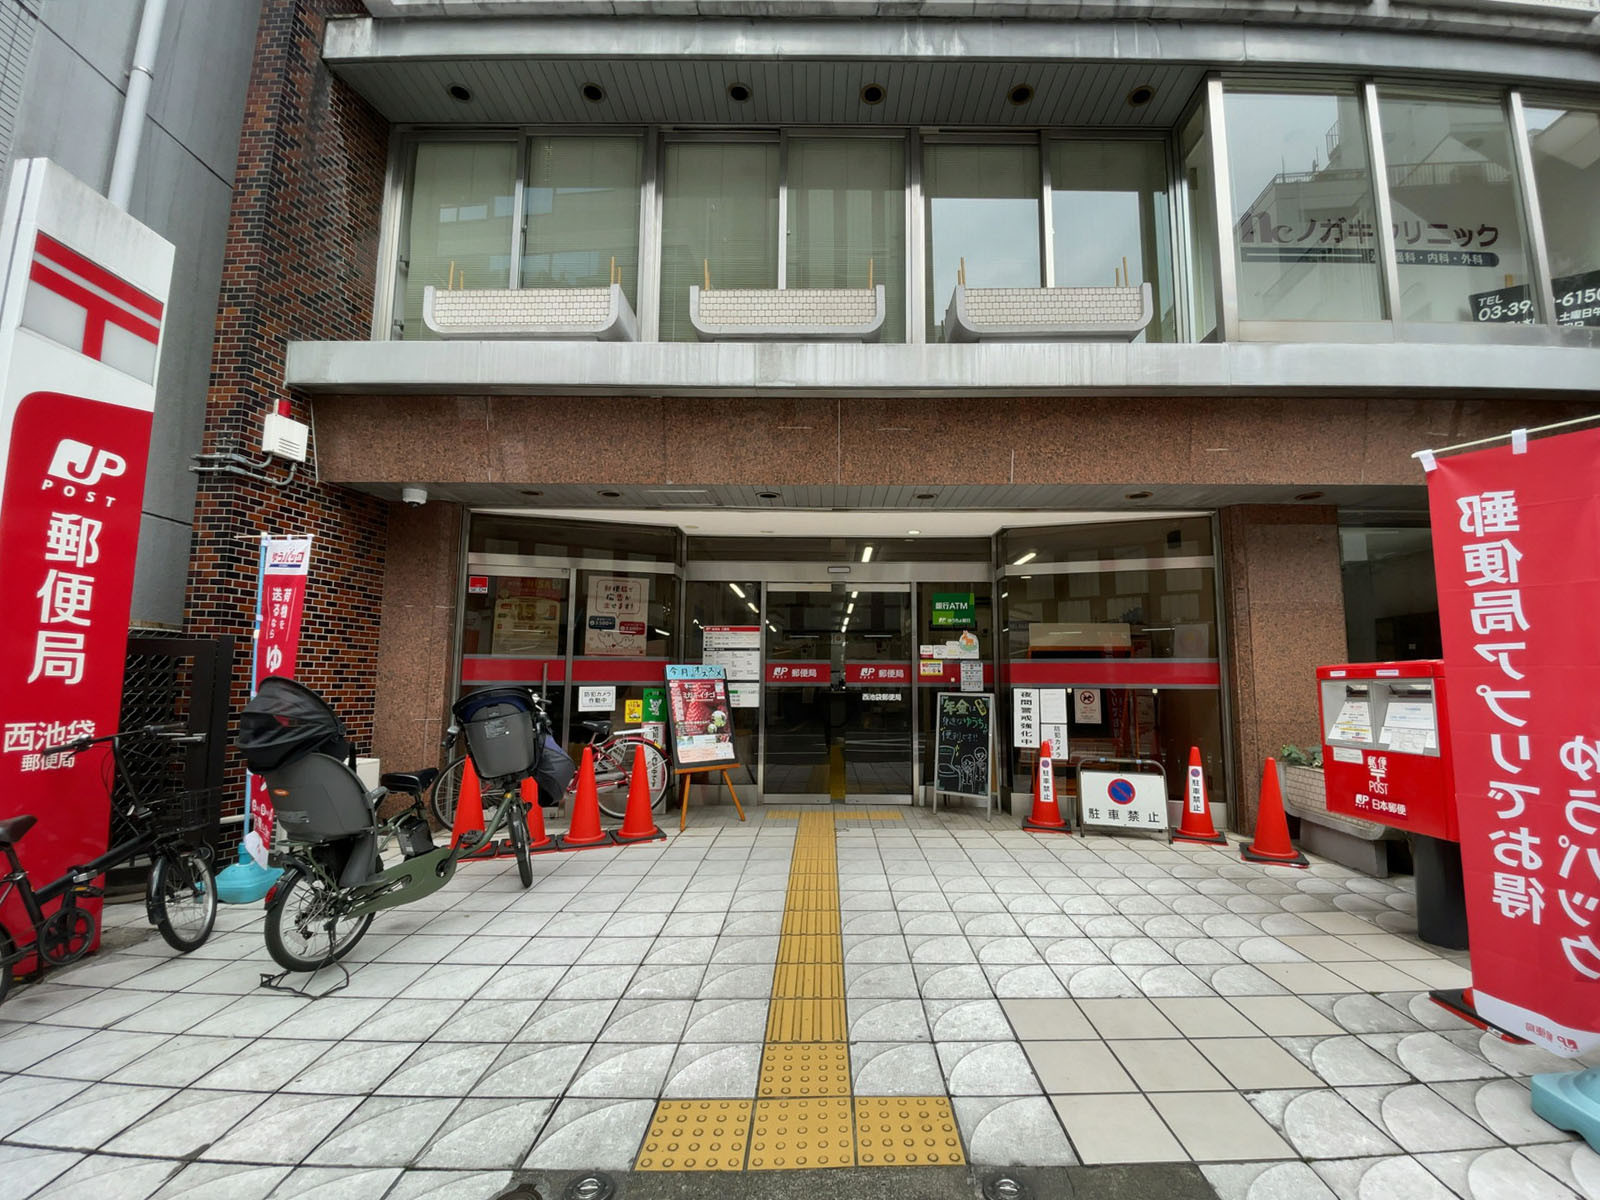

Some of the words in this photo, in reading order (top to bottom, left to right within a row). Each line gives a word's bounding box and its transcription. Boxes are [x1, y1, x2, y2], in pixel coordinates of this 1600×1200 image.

[1478, 295, 1504, 307] TEL
[47, 438, 127, 486] JP
[41, 478, 117, 508] POST
[27, 511, 103, 686] 郵便局
[935, 602, 968, 610] 銀行ATM
[269, 587, 283, 639] 送るなら
[791, 668, 817, 678] 郵便局
[878, 669, 904, 678] 郵便局
[862, 693, 902, 701] 西池袋郵便局
[1020, 691, 1032, 745] 夜間警戒強化中
[1053, 726, 1062, 758] 防犯カメラ
[20, 752, 76, 773] 郵便局
[1367, 756, 1387, 771] 郵便
[1042, 770, 1051, 801] 駐車禁止
[1369, 780, 1389, 795] POST
[1192, 779, 1201, 812] 駐車禁止
[1088, 808, 1160, 823] 駐車禁止
[1372, 798, 1407, 816] 日本郵便
